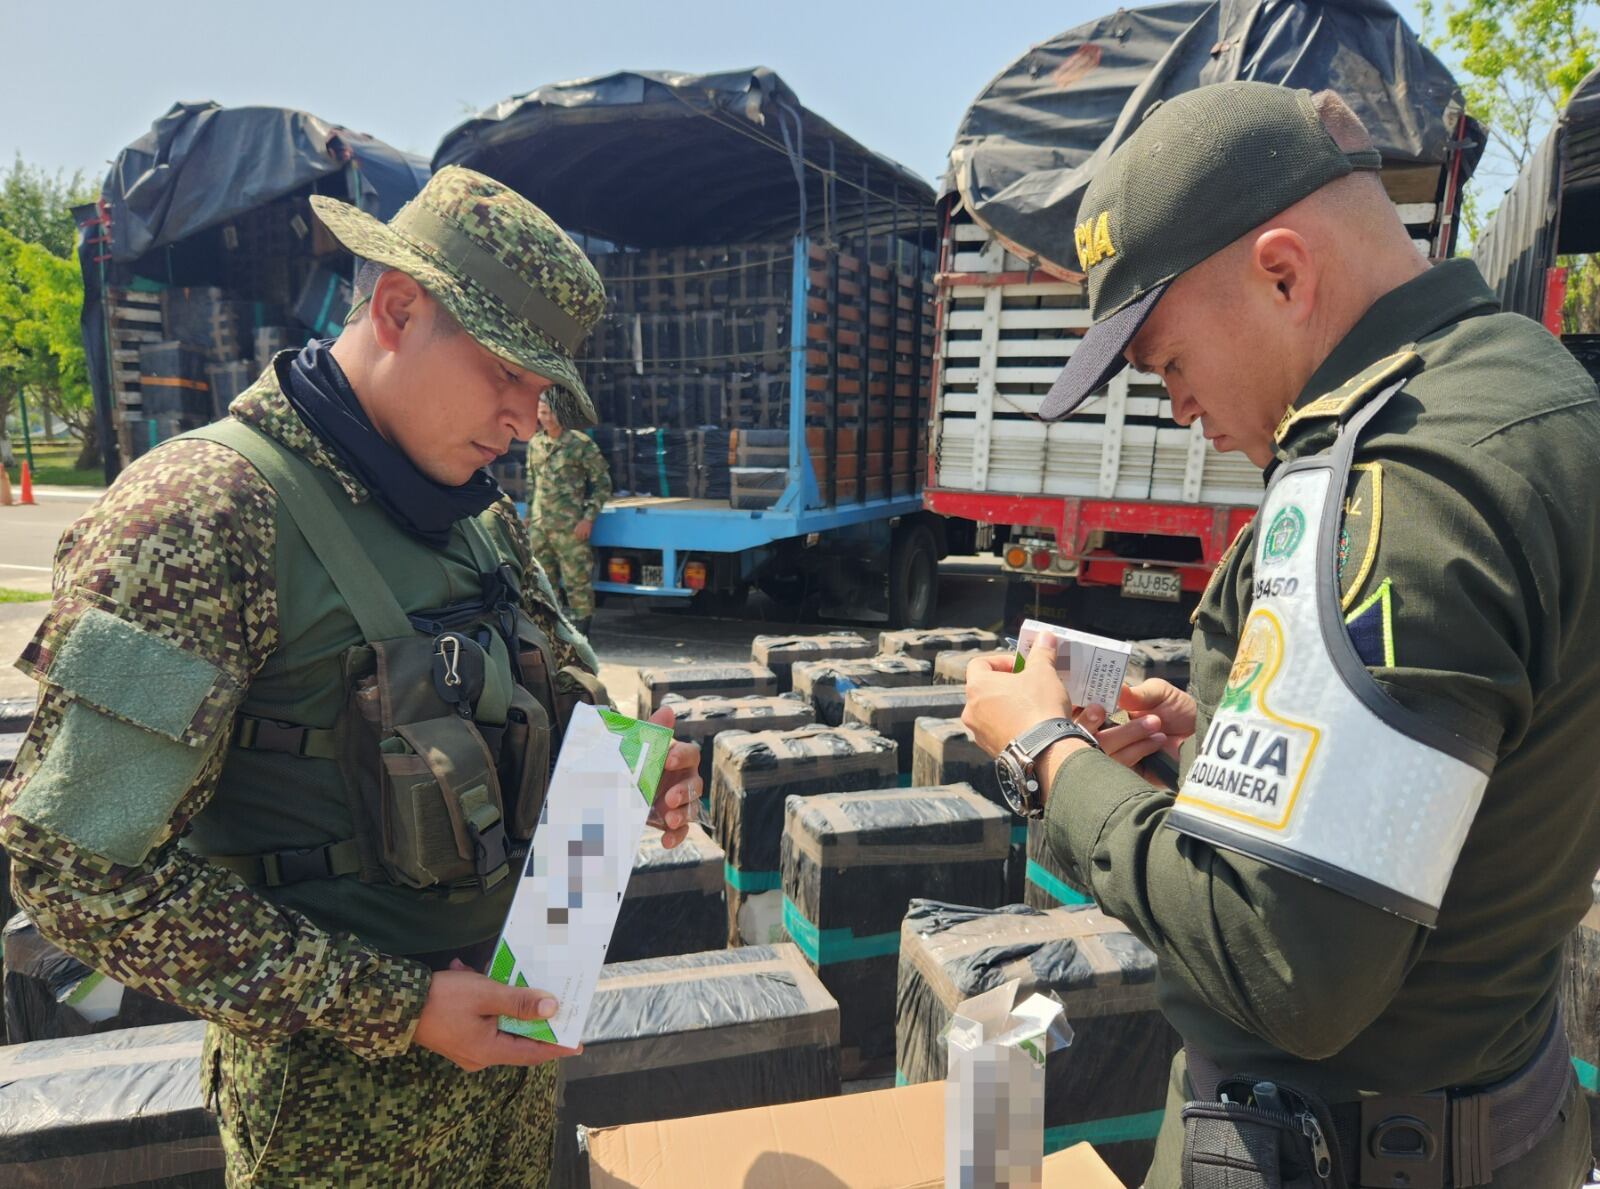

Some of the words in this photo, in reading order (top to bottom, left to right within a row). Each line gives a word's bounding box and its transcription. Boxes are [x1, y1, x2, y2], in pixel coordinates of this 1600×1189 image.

[1087, 657, 1103, 702] ADVERTENCIA
[1095, 673, 1105, 697] FUMAR
[1108, 659, 1116, 678] PARA
[1202, 721, 1288, 777] ICIA
[1190, 762, 1280, 806] ADUANERA
